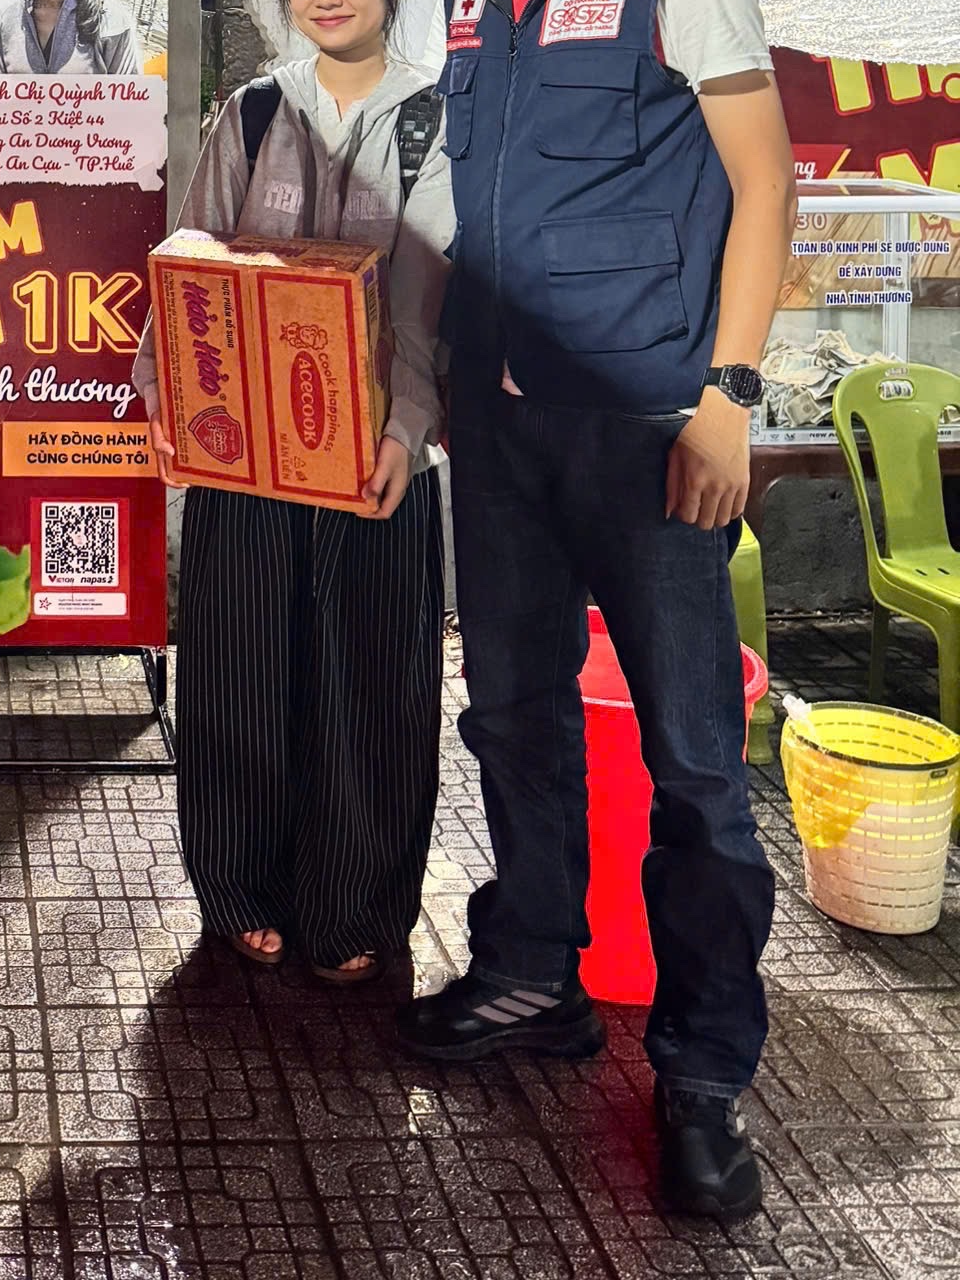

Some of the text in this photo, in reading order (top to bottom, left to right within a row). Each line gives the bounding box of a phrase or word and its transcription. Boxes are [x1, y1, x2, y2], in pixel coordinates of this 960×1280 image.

[14, 81, 46, 104] Chị
[48, 82, 106, 108] Quỳnh
[108, 81, 150, 101] Như
[10, 110, 32, 126] Số
[35, 115, 44, 125] 2
[48, 110, 84, 129] Kiệt
[86, 115, 105, 126] 44
[9, 133, 33, 149] An
[35, 133, 83, 155] Dương
[86, 133, 133, 155] Vương
[6, 155, 30, 171] An
[32, 155, 62, 174] Cựu
[75, 155, 136, 173] TP.Huế
[820, 239, 833, 255] BỘ
[835, 242, 859, 253] KINH
[861, 240, 878, 253] PHÍ
[854, 265, 873, 277] XÂY
[826, 290, 911, 304] NHÀ TÌNH THƯƠNG
[12, 270, 143, 355] 1K
[181, 280, 218, 337] Hảo
[221, 278, 230, 296] THỰC
[226, 330, 234, 349] SUNG
[192, 339, 229, 396] Hảo
[24, 365, 137, 418] thương
[318, 352, 340, 453] Cook happiness
[28, 430, 148, 447] HÃY ĐỒNG HÀNH
[26, 450, 150, 466] CÙNG CHÚNG TÔI
[80, 577, 107, 585] napas
